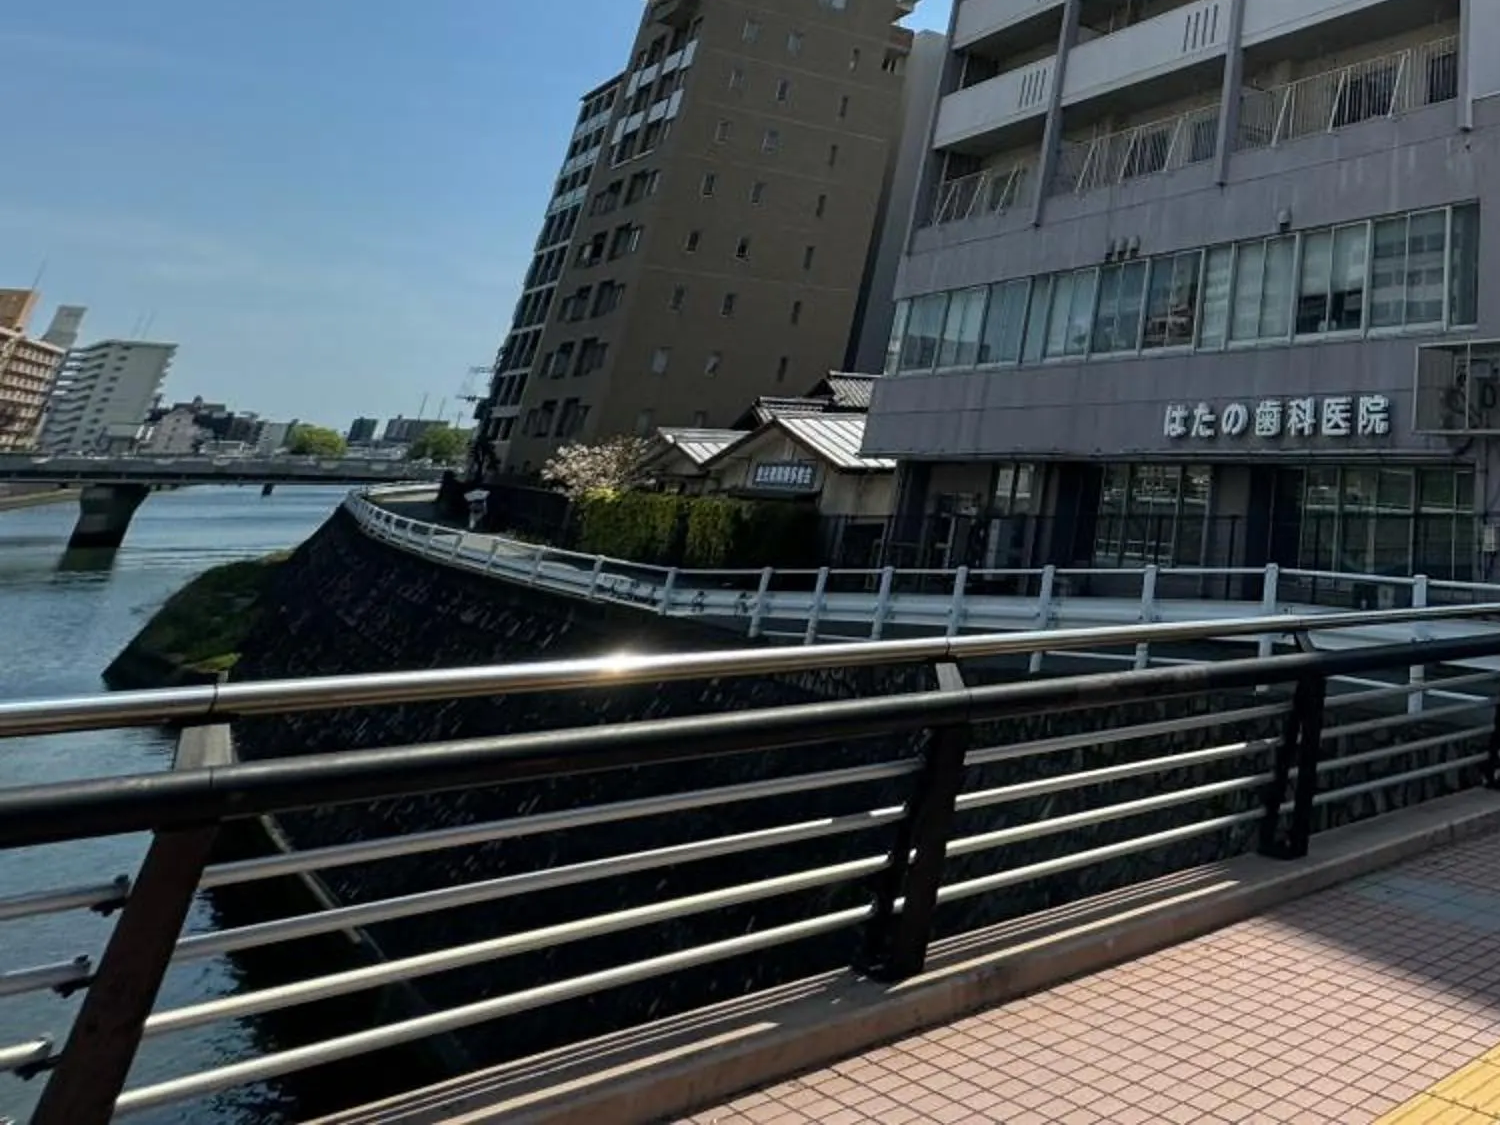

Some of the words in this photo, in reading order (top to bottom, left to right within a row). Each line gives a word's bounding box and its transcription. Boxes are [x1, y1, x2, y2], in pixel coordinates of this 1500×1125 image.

[1163, 394, 1390, 437] はたの歯科医院
